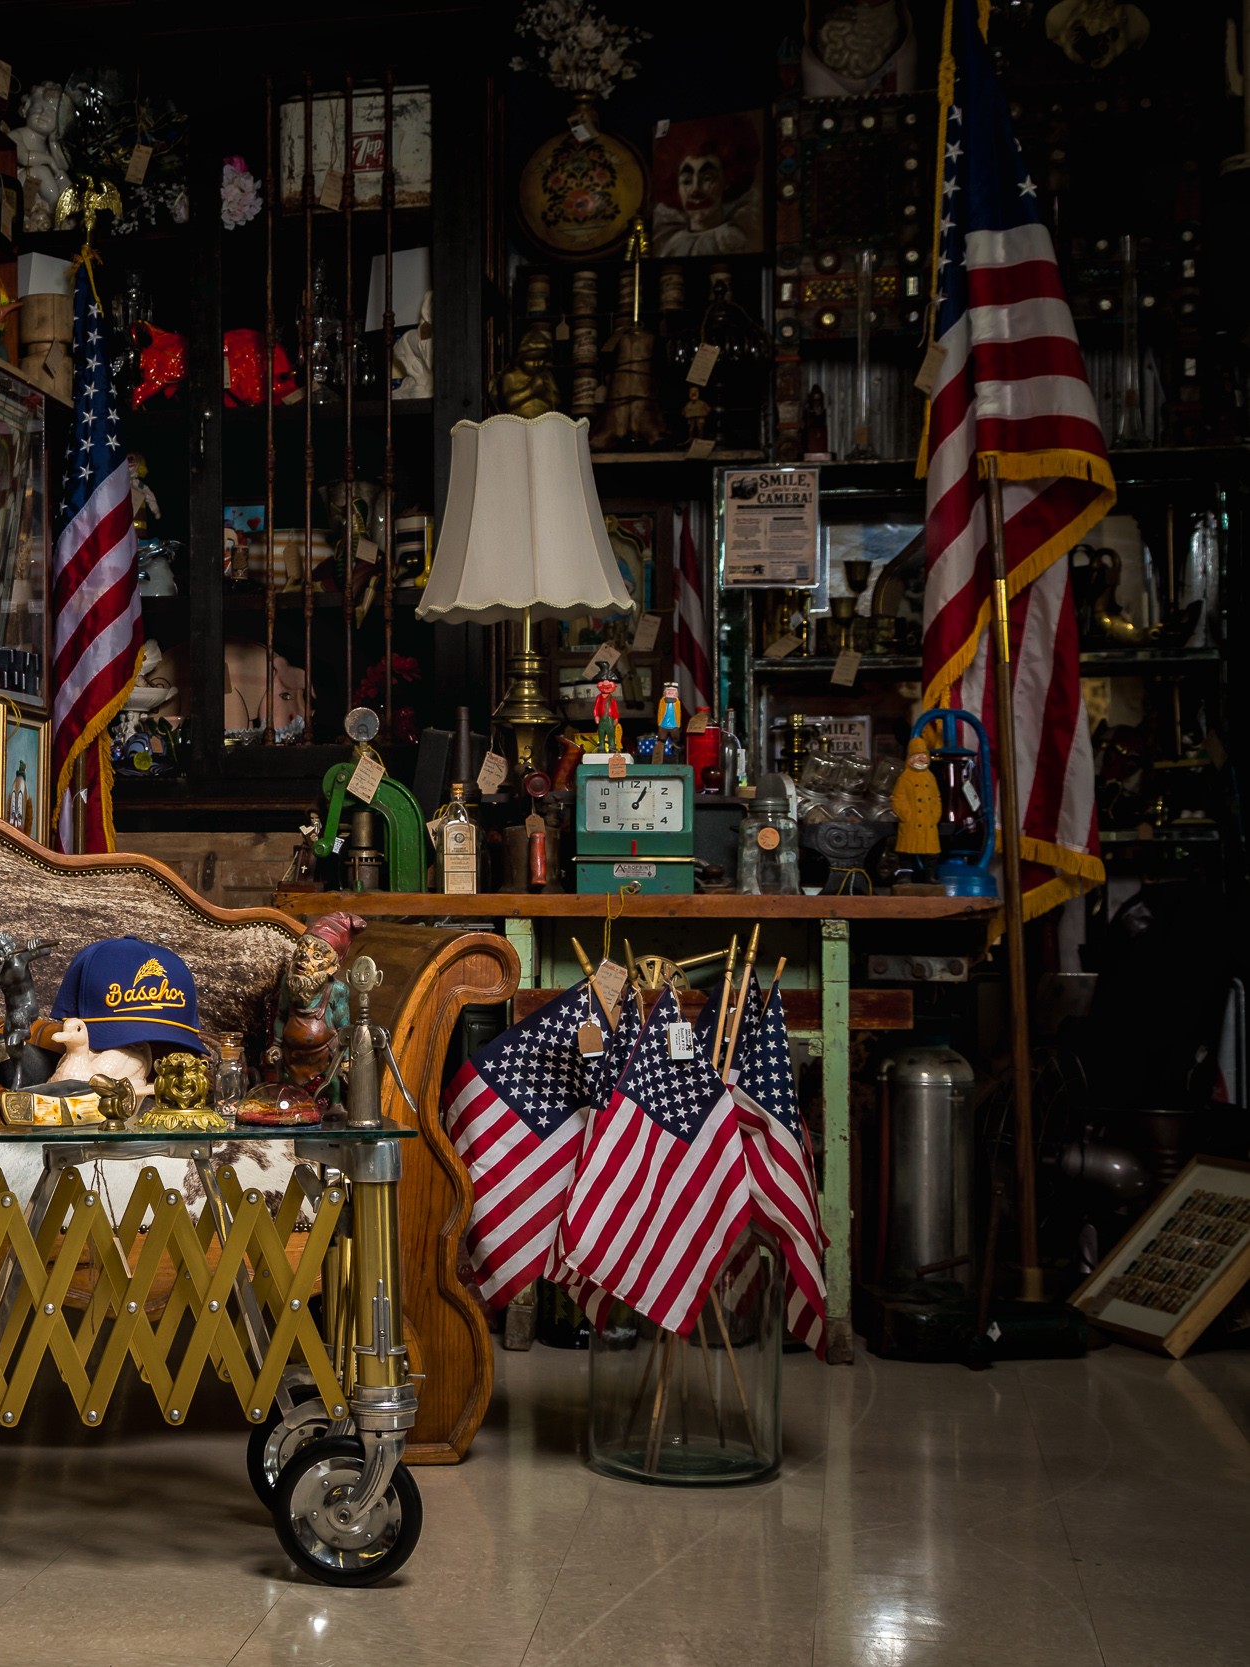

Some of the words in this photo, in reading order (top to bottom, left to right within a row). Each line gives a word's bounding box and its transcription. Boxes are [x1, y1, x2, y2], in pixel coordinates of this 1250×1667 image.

[759, 474, 810, 488] SMILE,
[757, 493, 812, 503] CAMERA!
[600, 788, 610, 796] 10
[603, 816, 610, 824] 8
[660, 816, 668, 824] 4
[615, 864, 652, 873] ACROPRINT
[105, 978, 186, 1008] Basehor
